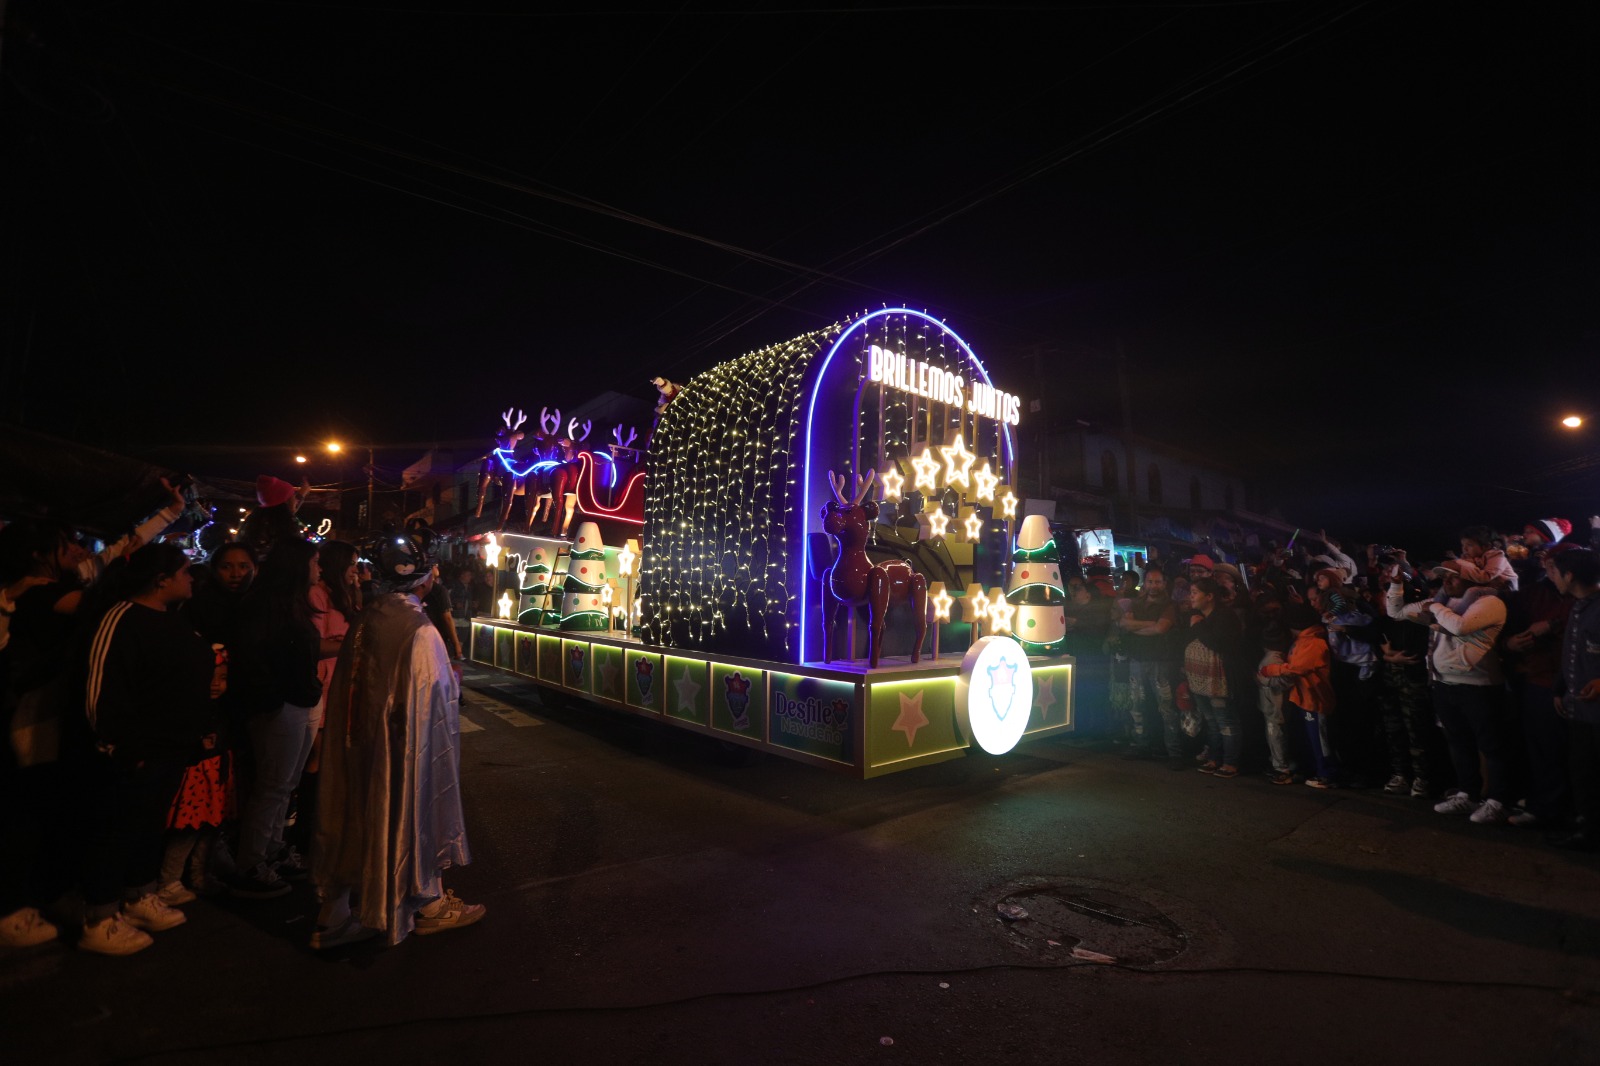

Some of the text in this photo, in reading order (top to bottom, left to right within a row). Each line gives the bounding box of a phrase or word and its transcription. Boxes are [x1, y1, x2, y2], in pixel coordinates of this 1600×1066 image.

[868, 345, 1020, 425] BRILLEMOS JUNTOS
[776, 691, 832, 725] Desfile
